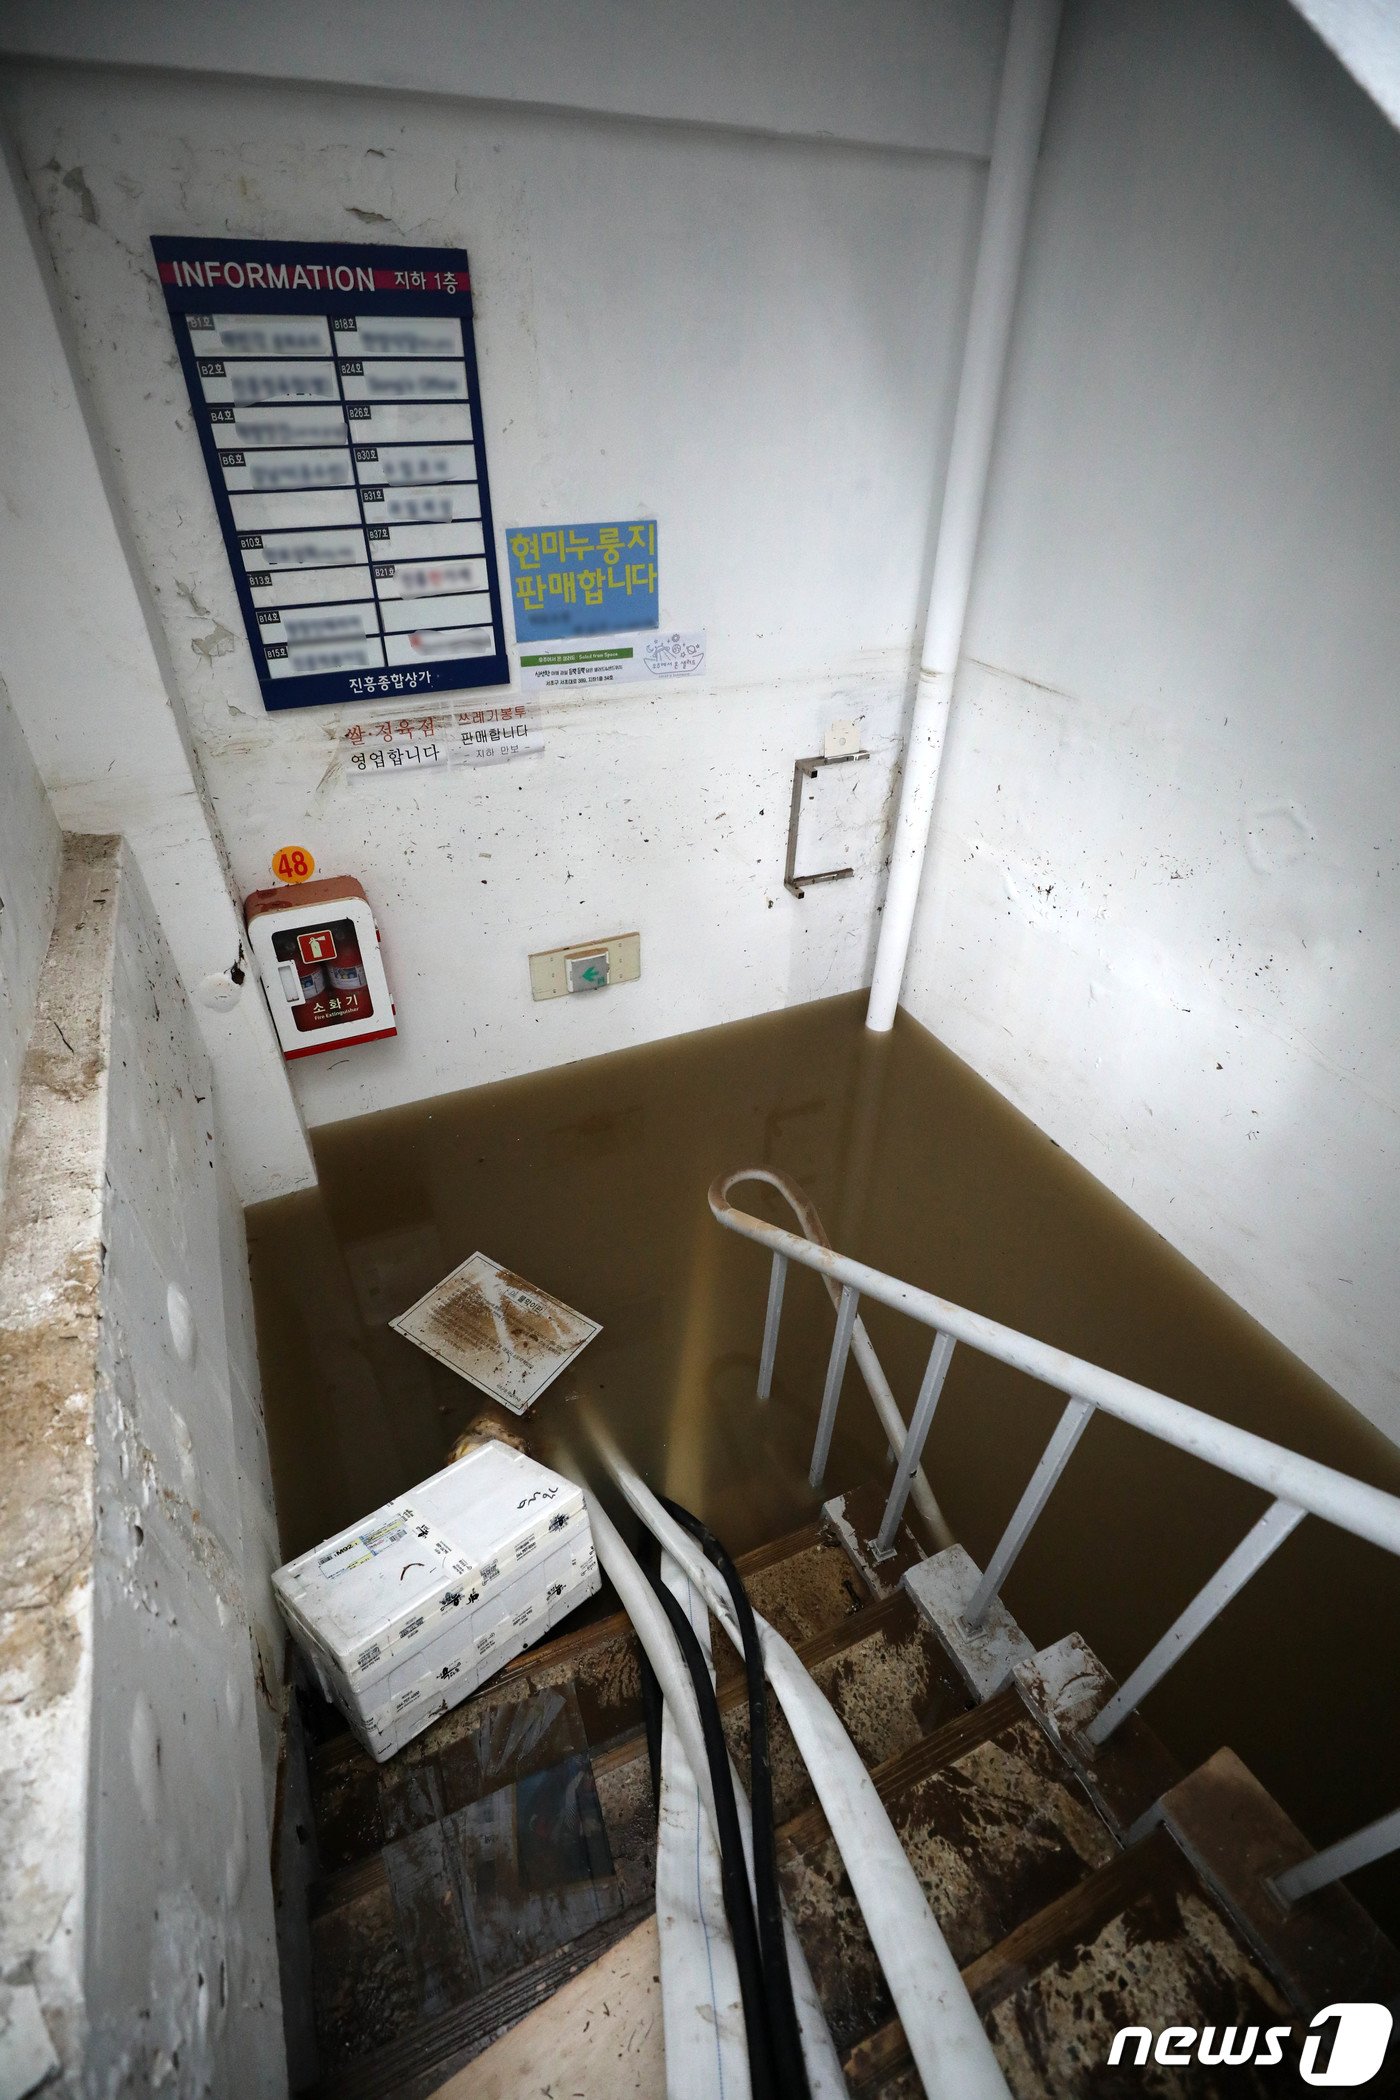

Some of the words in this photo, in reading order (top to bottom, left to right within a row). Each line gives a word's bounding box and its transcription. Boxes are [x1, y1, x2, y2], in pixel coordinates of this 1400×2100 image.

[172, 260, 376, 292] INFORMATION
[395, 272, 426, 290] 지하
[434, 272, 458, 294] 1층
[334, 318, 355, 330] B18호
[201, 363, 225, 375] B2호
[341, 362, 363, 374] B24호
[211, 410, 234, 422] B4호
[349, 406, 371, 418] B26호
[222, 454, 245, 466] B6호
[356, 450, 378, 461] B30호
[363, 490, 383, 500] B31호
[369, 528, 389, 539] B37호
[241, 536, 262, 548] B10호
[511, 523, 655, 569] 현미누룽지
[375, 566, 395, 577] B21호
[249, 574, 271, 586] B13호
[516, 563, 657, 610] 판매합니다
[259, 612, 280, 623] B14호
[267, 647, 287, 658] B15호
[349, 671, 431, 695] 진흥종합상가
[458, 705, 527, 725] 쓰레기봉투
[461, 724, 529, 746] 판매합니다
[351, 744, 440, 770] 영업합니다
[476, 747, 495, 758] 지하
[278, 850, 308, 878] 48
[314, 1012, 325, 1021] Fire
[325, 1007, 360, 1020] Extinguisher
